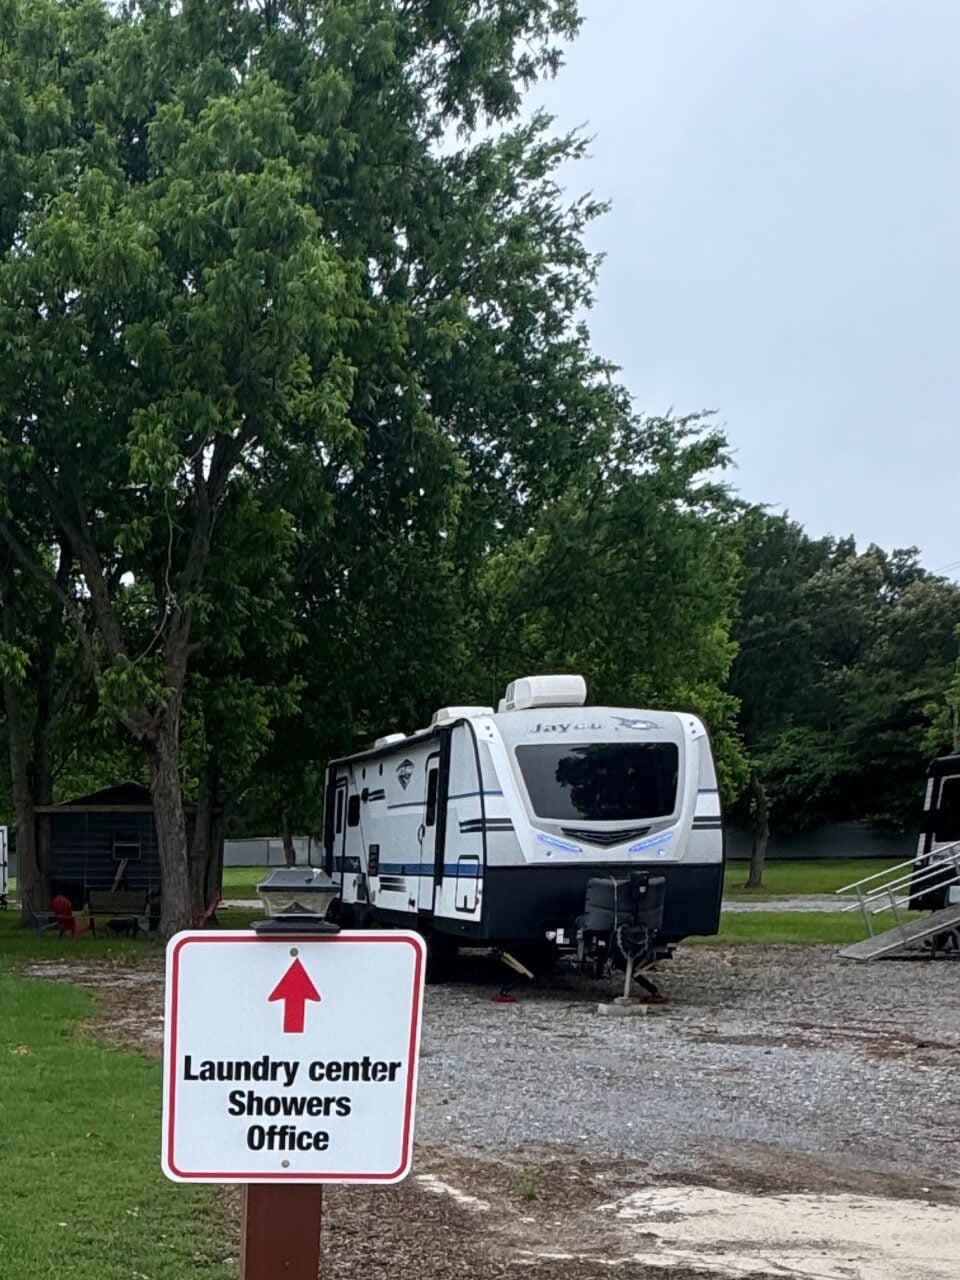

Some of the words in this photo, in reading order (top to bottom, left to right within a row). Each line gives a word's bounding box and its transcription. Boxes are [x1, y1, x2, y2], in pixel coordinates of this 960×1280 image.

[183, 1055, 300, 1087] Laundry
[308, 1056, 402, 1082] center
[227, 1090, 352, 1117] Showers
[246, 1125, 330, 1151] Office
